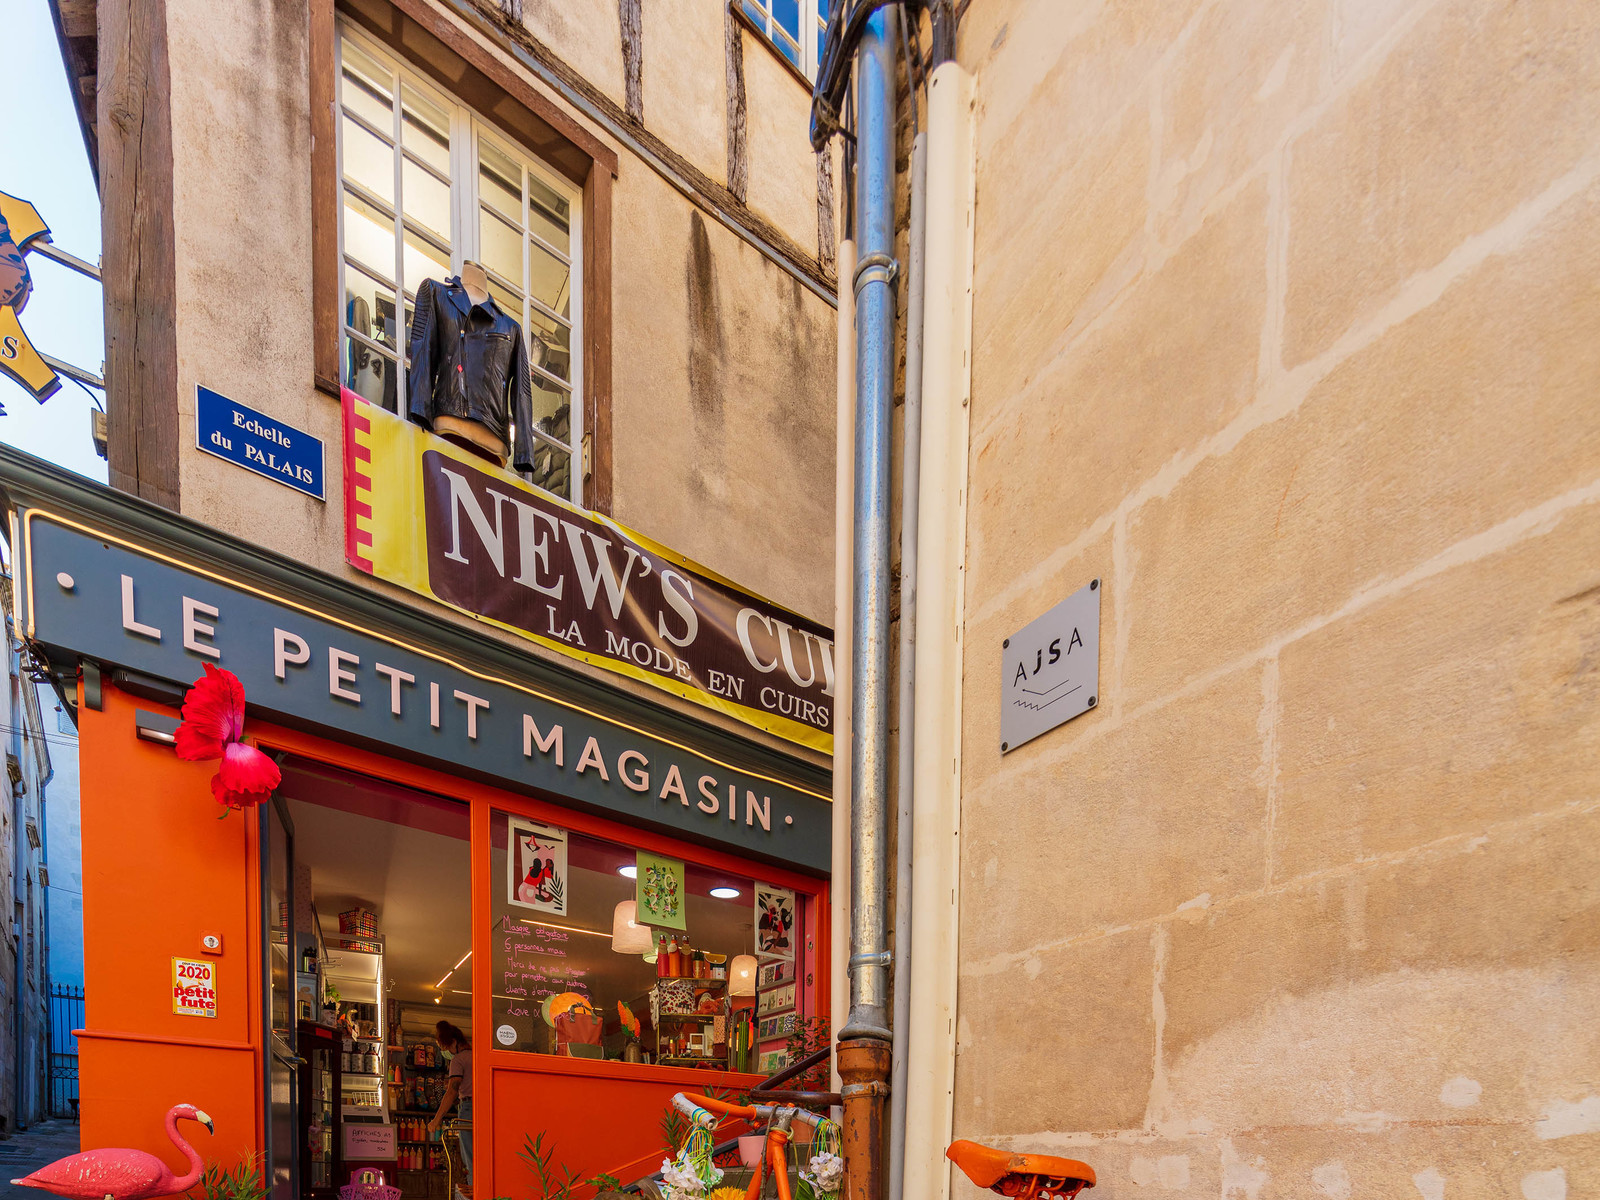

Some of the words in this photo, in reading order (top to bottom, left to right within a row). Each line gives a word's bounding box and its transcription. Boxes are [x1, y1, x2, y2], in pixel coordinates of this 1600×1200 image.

[232, 410, 291, 448] Echelle
[211, 430, 233, 451] du
[244, 443, 313, 485] PALAIS
[440, 466, 699, 648] NEW'S
[546, 604, 586, 647] LA
[605, 630, 692, 682] MODE
[707, 669, 745, 700] EN
[760, 686, 829, 728] CUIRS
[120, 573, 221, 659] LE
[274, 627, 490, 740] PETIT
[522, 713, 771, 831] MAGASIN
[504, 937, 512, 952] 6
[178, 965, 210, 979] 2020
[174, 987, 215, 999] petit
[507, 1000, 530, 1017] Love
